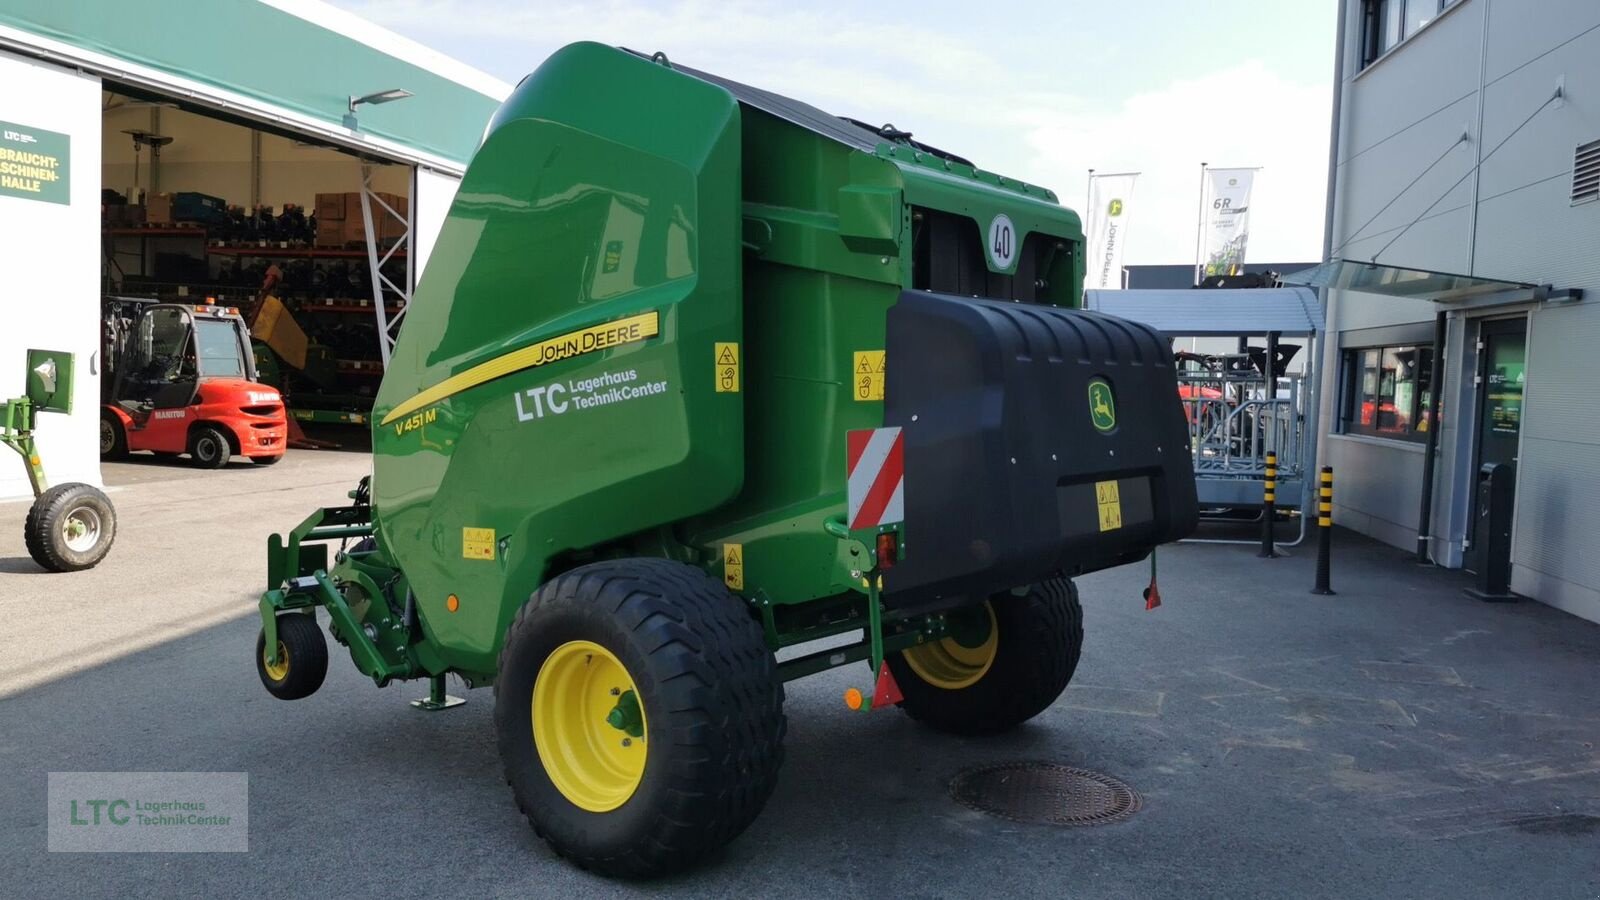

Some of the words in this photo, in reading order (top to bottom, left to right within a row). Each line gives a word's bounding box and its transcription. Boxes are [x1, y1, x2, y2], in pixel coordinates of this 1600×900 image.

[4, 130, 20, 141] LTC
[0, 161, 60, 182] SCHINEN-
[1, 175, 41, 193] HALLE
[1213, 197, 1232, 210] 6R
[994, 224, 1010, 260] 40
[1106, 221, 1118, 251] JOHN
[536, 338, 579, 363] JOHN
[582, 323, 641, 350] DEERE
[569, 368, 637, 393] Lagerhaus
[513, 382, 569, 422] LTC
[571, 380, 667, 410] TechnikCenter
[155, 410, 186, 420] MANITOU
[395, 421, 404, 436] V
[404, 413, 424, 432] 451
[425, 407, 436, 424] M
